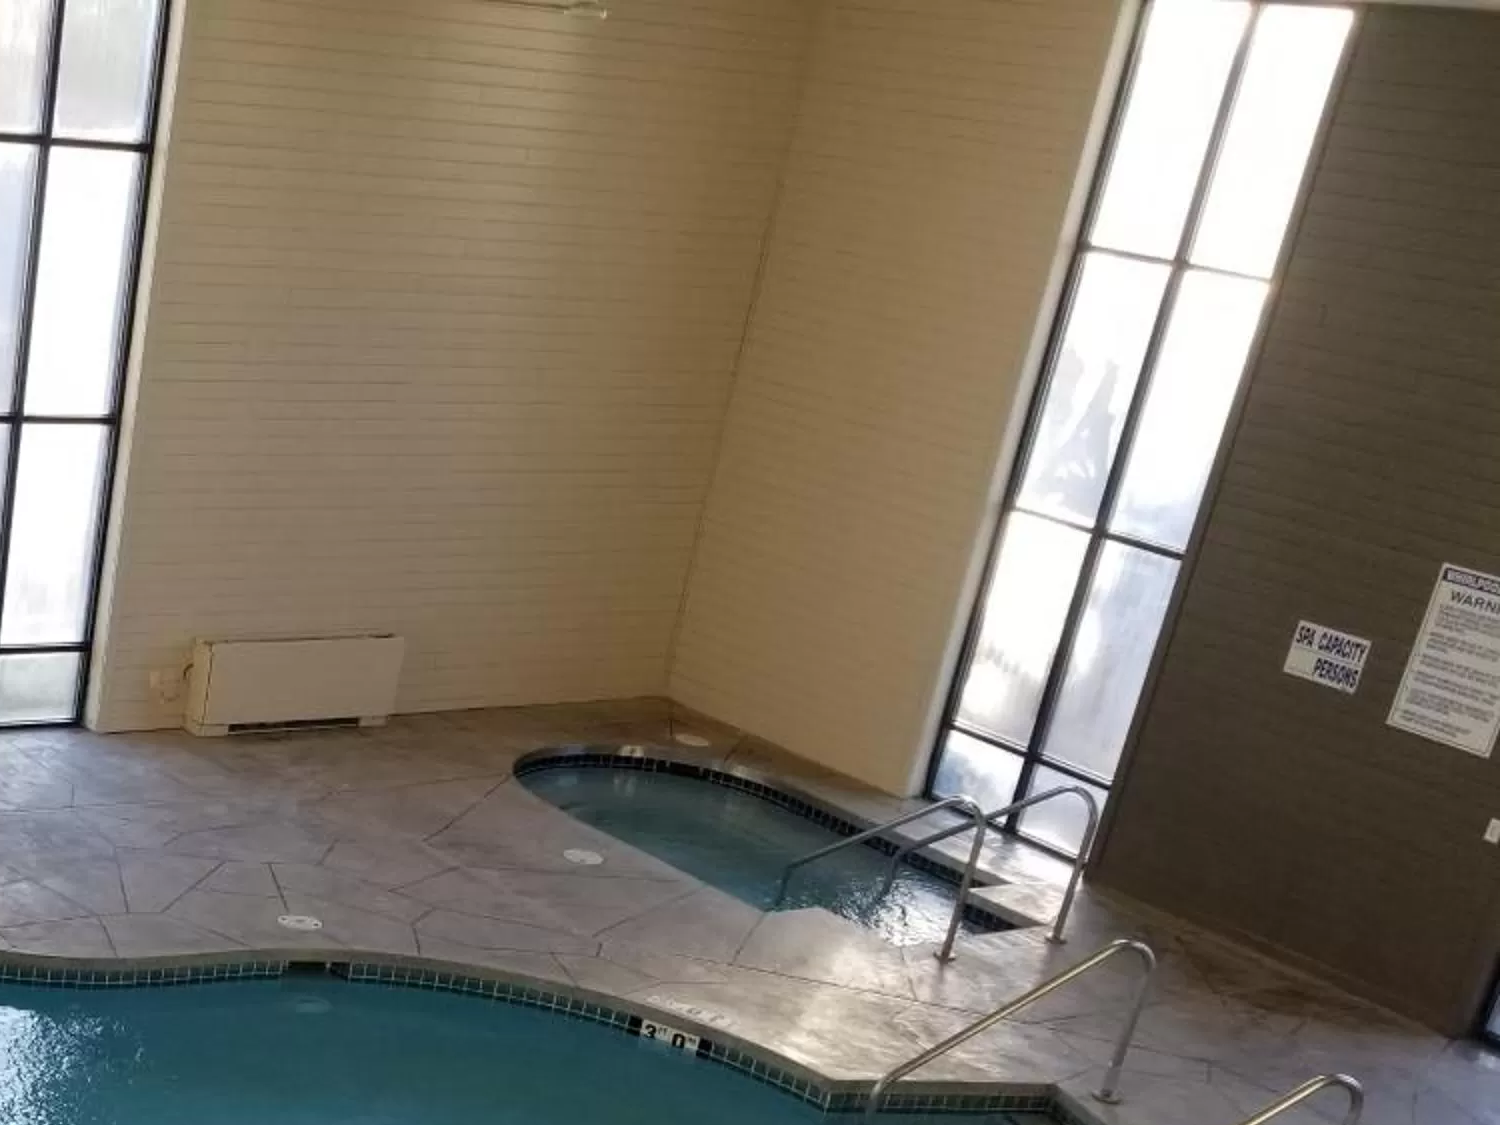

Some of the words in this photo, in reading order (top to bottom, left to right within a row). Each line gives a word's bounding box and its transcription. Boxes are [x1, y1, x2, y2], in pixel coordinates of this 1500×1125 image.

[1296, 625, 1317, 648] SPA
[1318, 632, 1368, 663] CAPACITY
[1313, 657, 1359, 689] PERSONS
